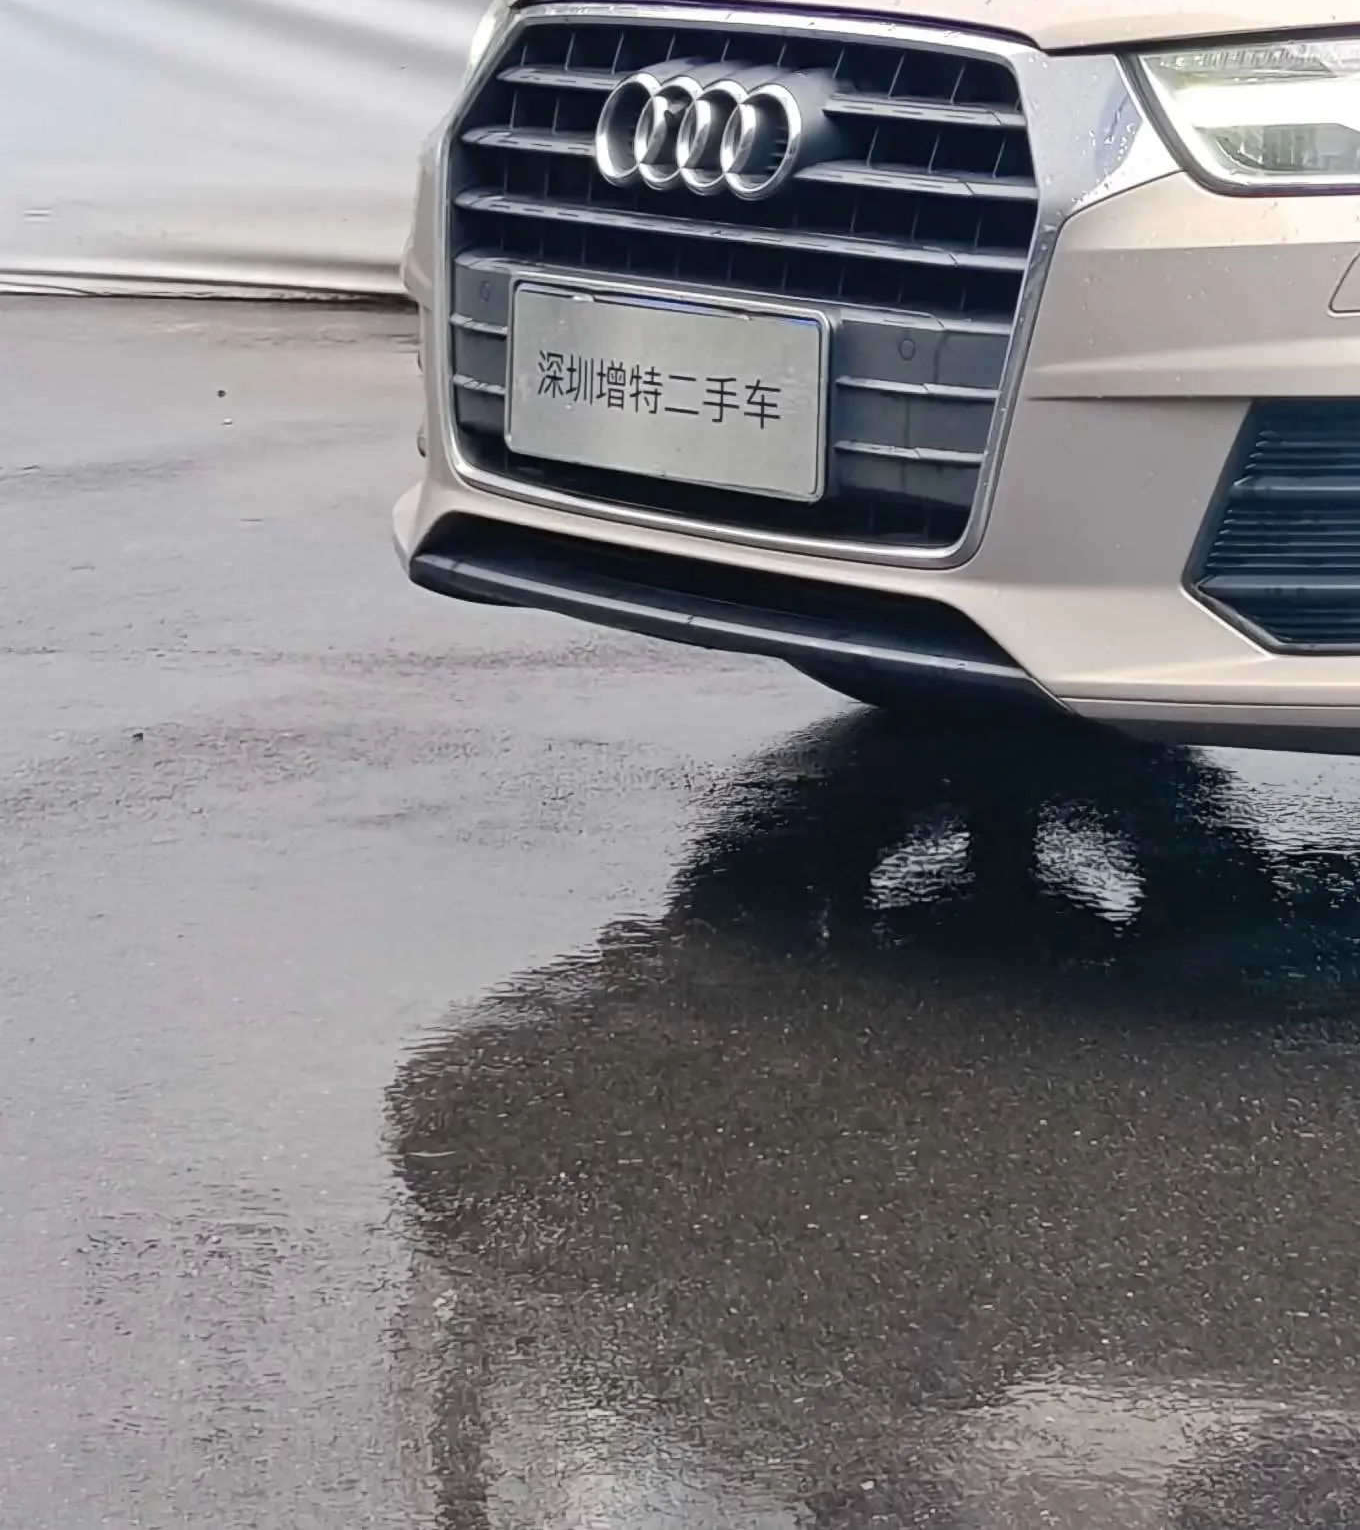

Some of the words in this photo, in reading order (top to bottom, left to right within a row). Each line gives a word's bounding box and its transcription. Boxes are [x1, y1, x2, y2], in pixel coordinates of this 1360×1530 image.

[537, 350, 781, 430] 深圳增特二手车
